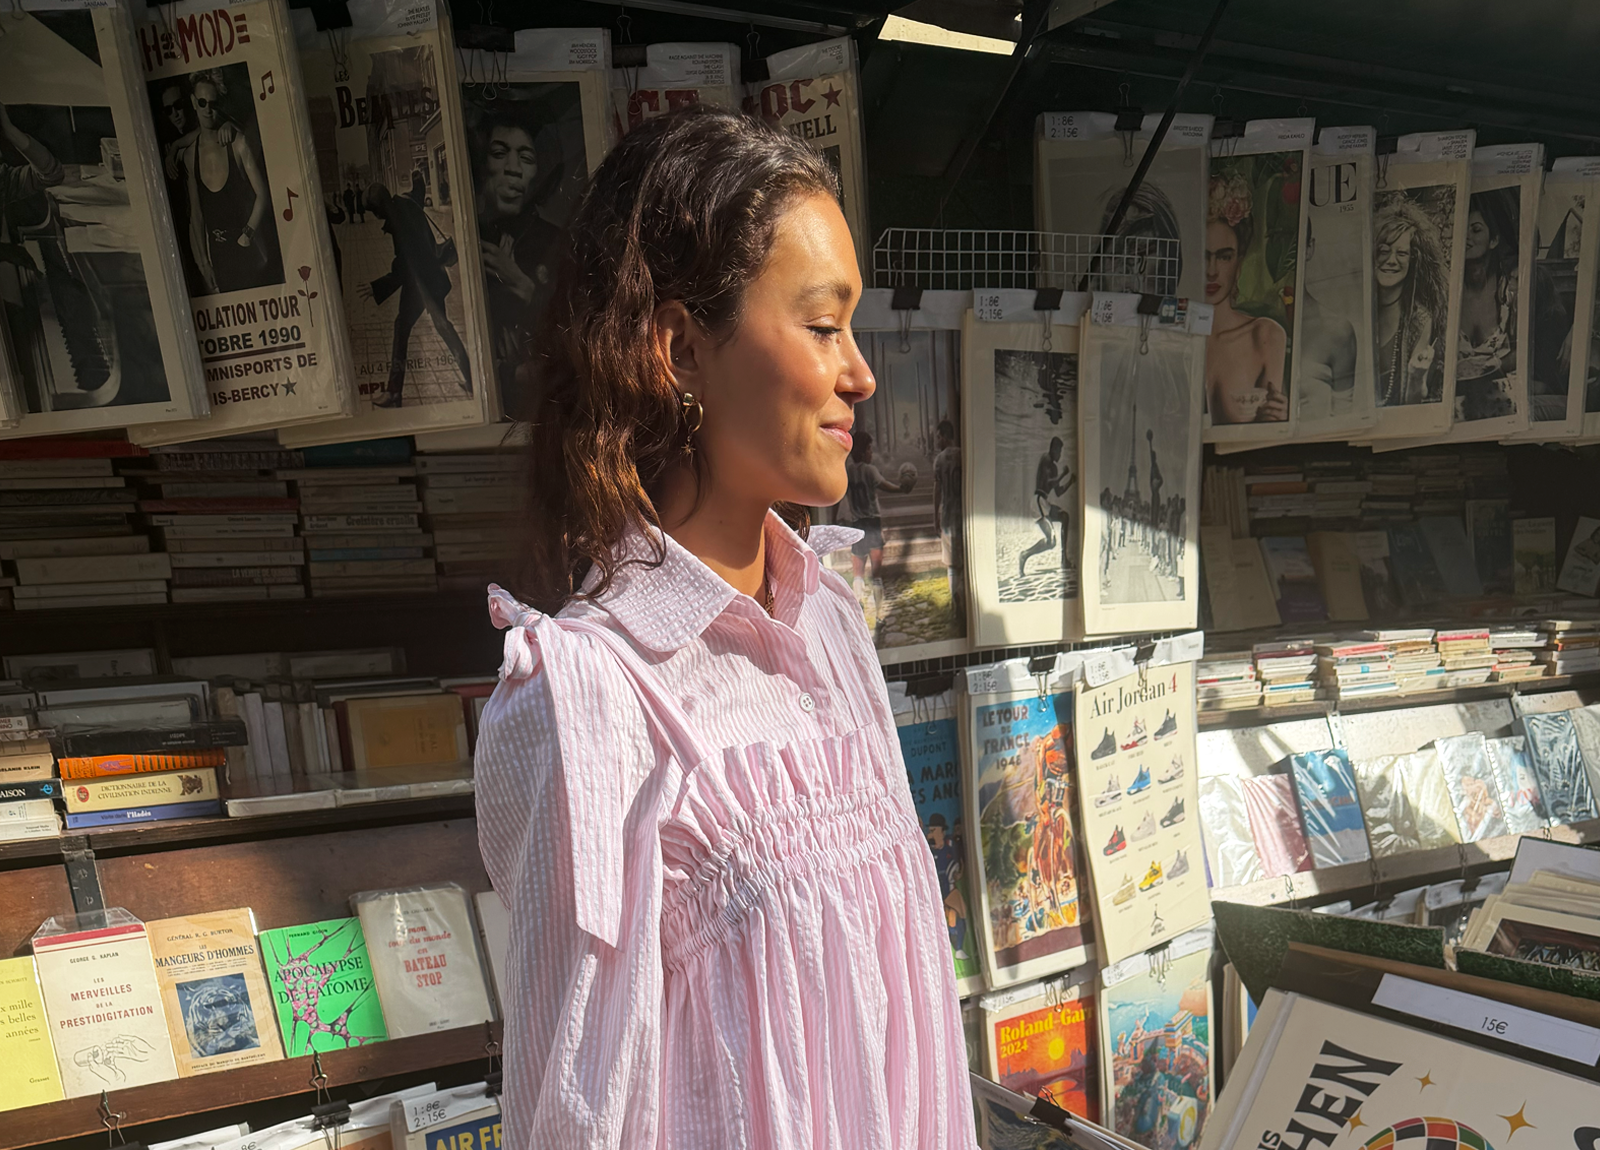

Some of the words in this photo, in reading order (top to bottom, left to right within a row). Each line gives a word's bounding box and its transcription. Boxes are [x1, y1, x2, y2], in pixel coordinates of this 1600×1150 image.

[177, 9, 250, 64] MODE
[1051, 127, 1078, 138] 2:15€
[1309, 162, 1357, 207] UE
[1339, 204, 1354, 213] 1955
[197, 302, 257, 331] OLATION
[259, 295, 300, 321] TOUR
[978, 308, 1003, 320] 2:15€
[201, 332, 253, 354] OBRE
[259, 325, 301, 346] 1990
[206, 357, 292, 381] MNISPORTS
[297, 353, 317, 368] DE
[213, 383, 279, 405] IS-BERCY
[1090, 691, 1114, 719] Air
[1116, 682, 1166, 714] Jordan
[1168, 672, 1177, 694] 4
[982, 709, 995, 728] LE
[997, 705, 1029, 725] TOUR
[1001, 725, 1012, 734] DE
[911, 741, 947, 757] DUPONT
[983, 732, 1030, 755] FRANCE
[97, 790, 139, 800] CIVILISATION
[101, 782, 147, 792] DICTIONNAIRE
[409, 934, 420, 945] du
[423, 930, 452, 943] monde
[70, 956, 89, 964] GEORGE
[100, 951, 119, 959] KAPLAN
[155, 952, 205, 968] MANGEURS
[206, 944, 255, 960] D'HOMMES
[417, 947, 428, 955] en
[275, 956, 363, 984] APOCALYPSE
[404, 954, 447, 973] BATEAU
[416, 971, 442, 988] STOP
[70, 984, 133, 1002] MERVEILLES
[279, 988, 300, 1005] DE
[306, 977, 368, 1001] L'ATOME
[9, 999, 33, 1011] mille
[7, 1012, 37, 1024] belles
[60, 1005, 154, 1029] PRESTIDIGITATION
[1480, 1015, 1508, 1035] 15€
[5, 1025, 39, 1038] années
[1000, 1040, 1029, 1059] 2024
[413, 1100, 440, 1116] 1:8€
[413, 1108, 447, 1128] 2:15€
